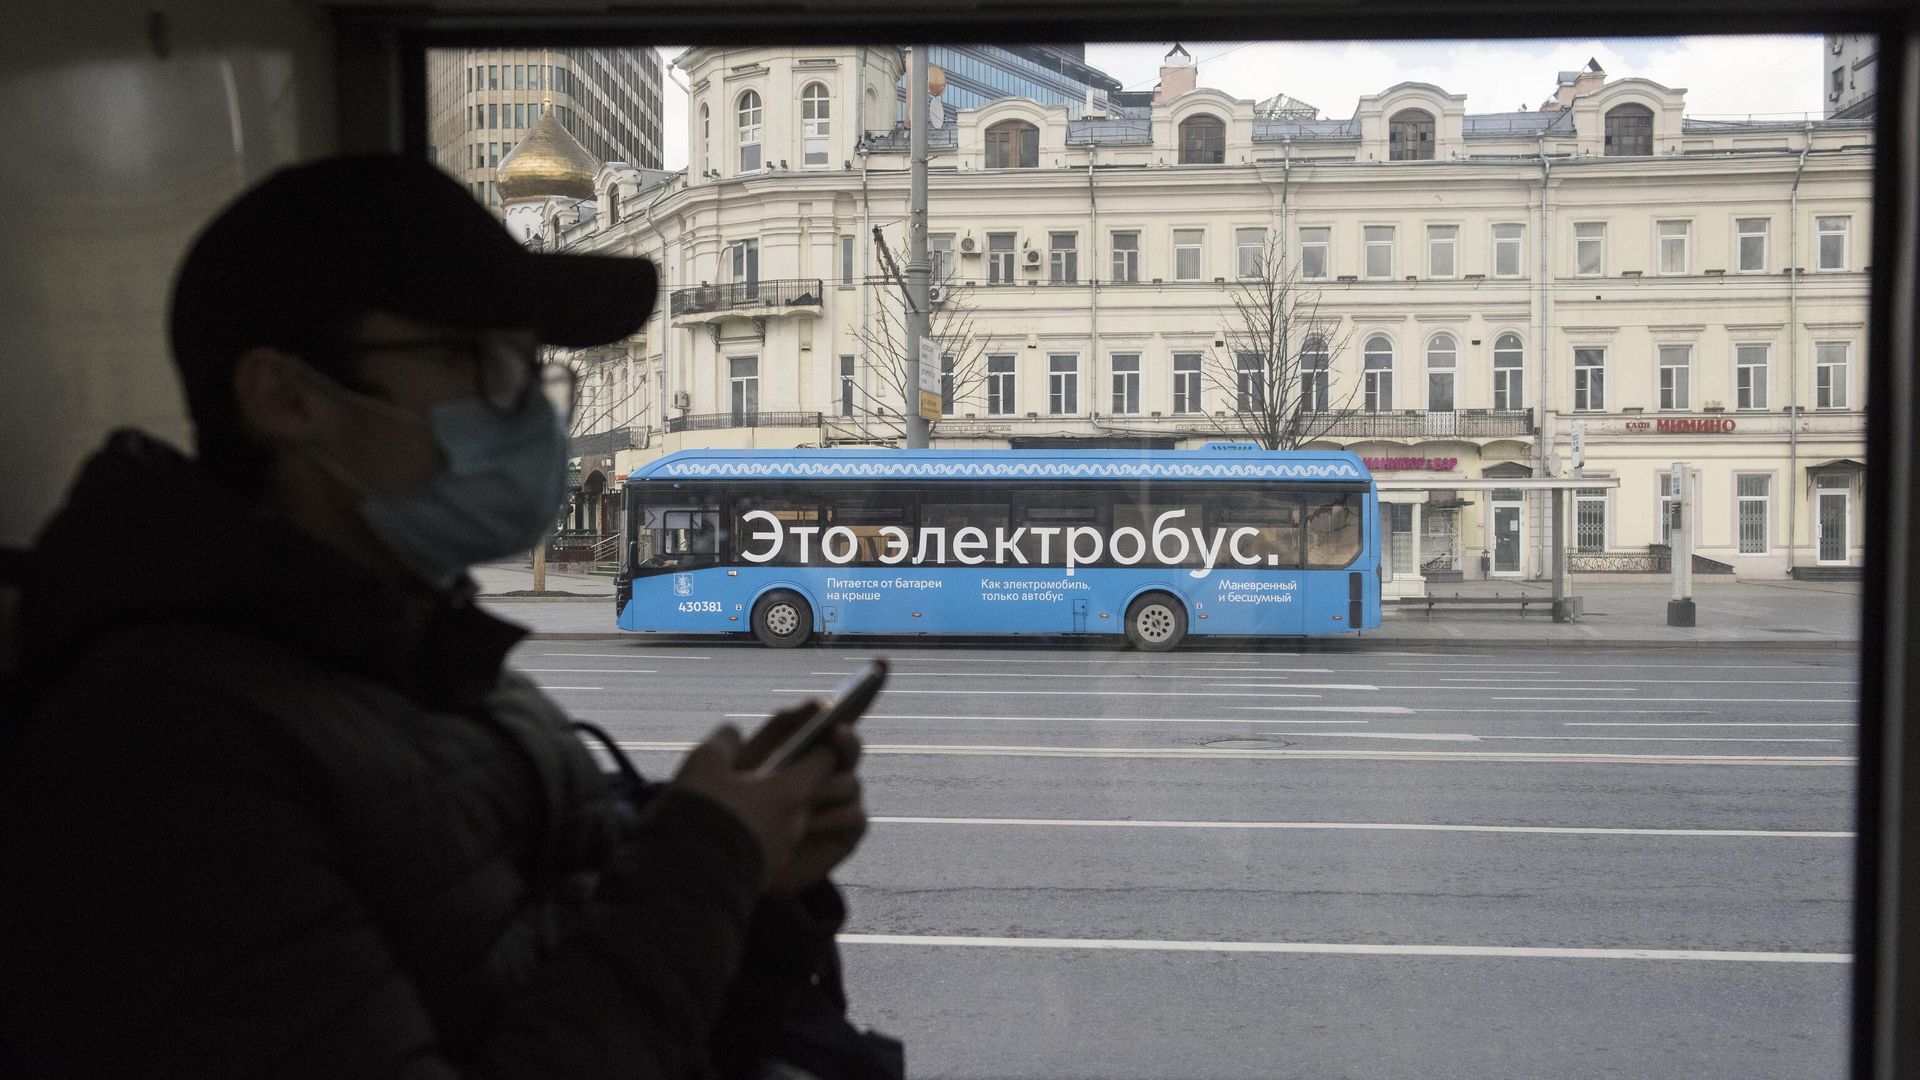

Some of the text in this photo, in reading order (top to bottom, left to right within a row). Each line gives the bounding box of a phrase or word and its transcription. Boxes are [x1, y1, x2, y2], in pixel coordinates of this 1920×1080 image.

[1656, 418, 1736, 433] МИМИНО
[741, 508, 1279, 578] Это электробус.
[827, 577, 942, 591] Питается от батареи
[981, 579, 1091, 592] Как электромобиль,
[1218, 579, 1298, 592] Маневренный
[827, 592, 881, 603] на крыше
[982, 591, 1064, 603] только автобус
[1218, 592, 1293, 605] и бесшумный
[678, 601, 723, 613] 430381
